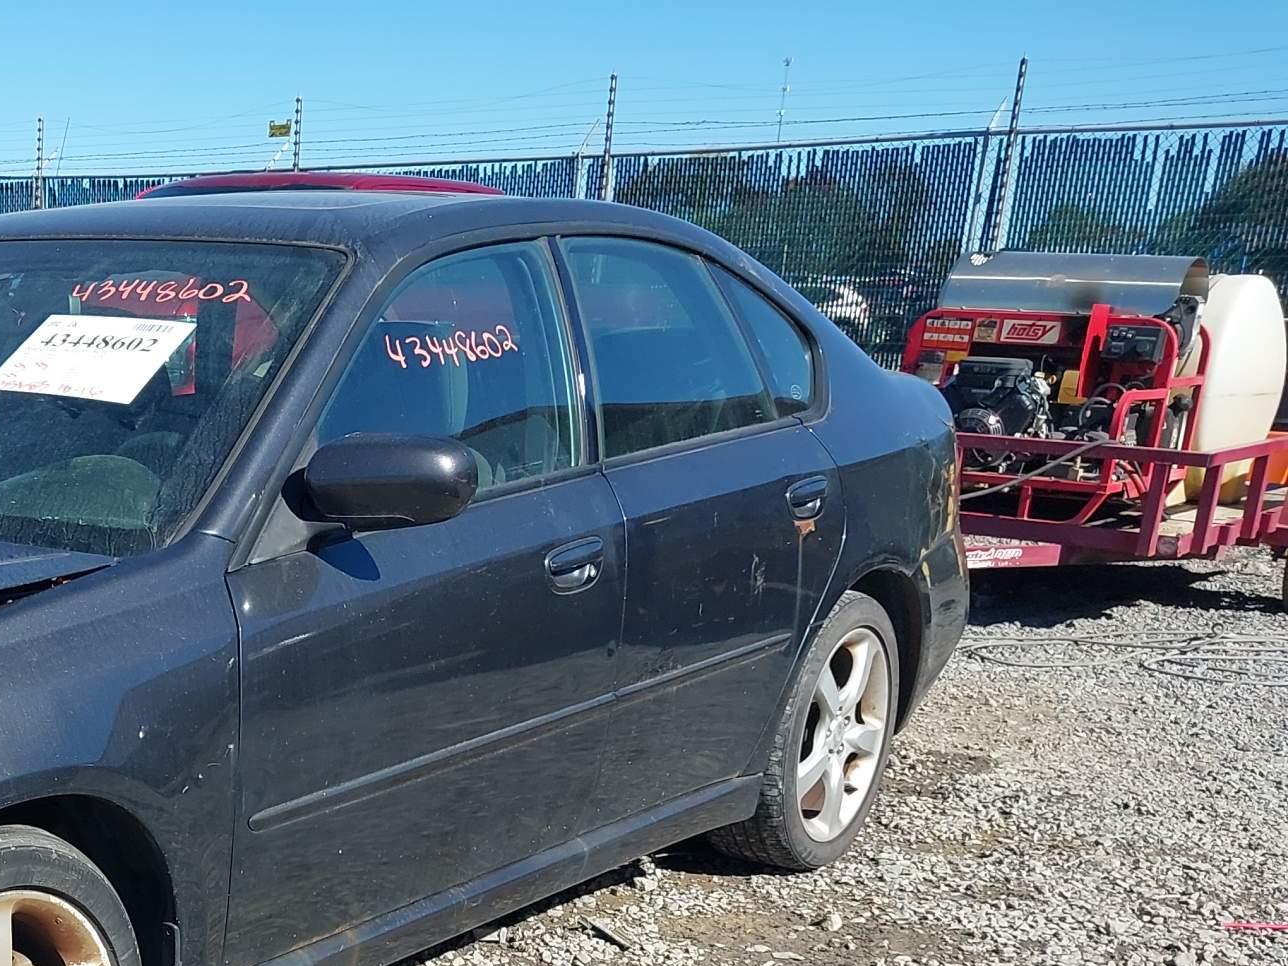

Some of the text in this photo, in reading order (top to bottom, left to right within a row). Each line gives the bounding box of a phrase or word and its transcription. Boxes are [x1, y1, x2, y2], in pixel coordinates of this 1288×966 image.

[72, 277, 251, 302] 43448602
[40, 332, 159, 352] 43448602
[1004, 321, 1057, 341] hotsy
[385, 325, 518, 369] 43448602
